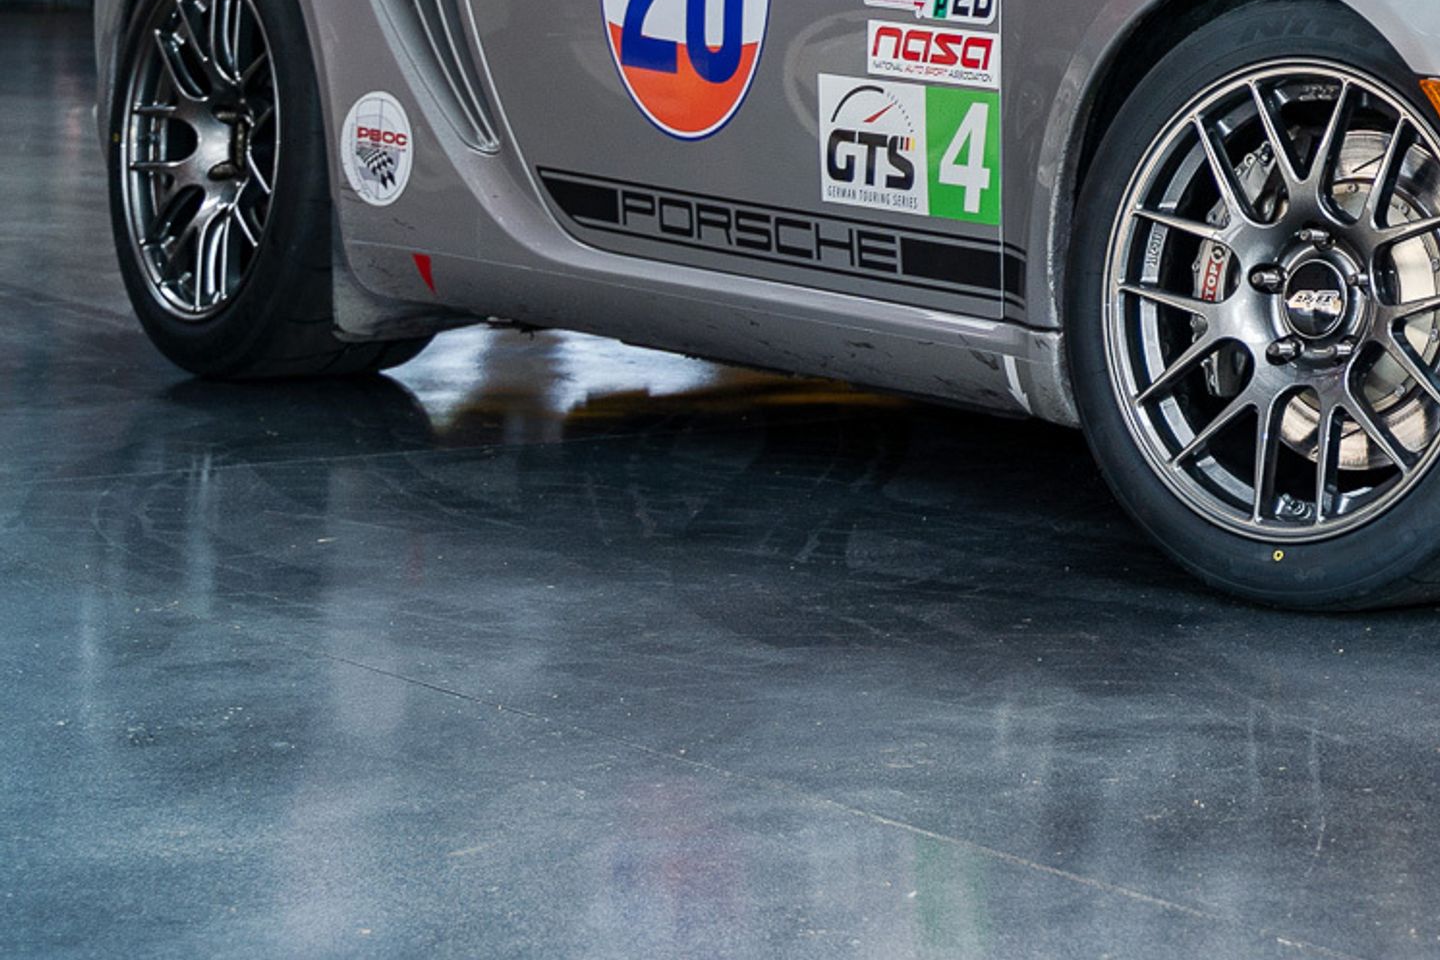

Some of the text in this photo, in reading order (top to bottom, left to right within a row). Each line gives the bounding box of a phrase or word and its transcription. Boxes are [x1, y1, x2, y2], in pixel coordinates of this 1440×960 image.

[872, 25, 993, 70] nasa
[827, 128, 914, 191] GTS
[938, 102, 991, 214] 4
[827, 185, 918, 209] GERMAN TOURING SERIES
[623, 191, 899, 273] PORSCHE
